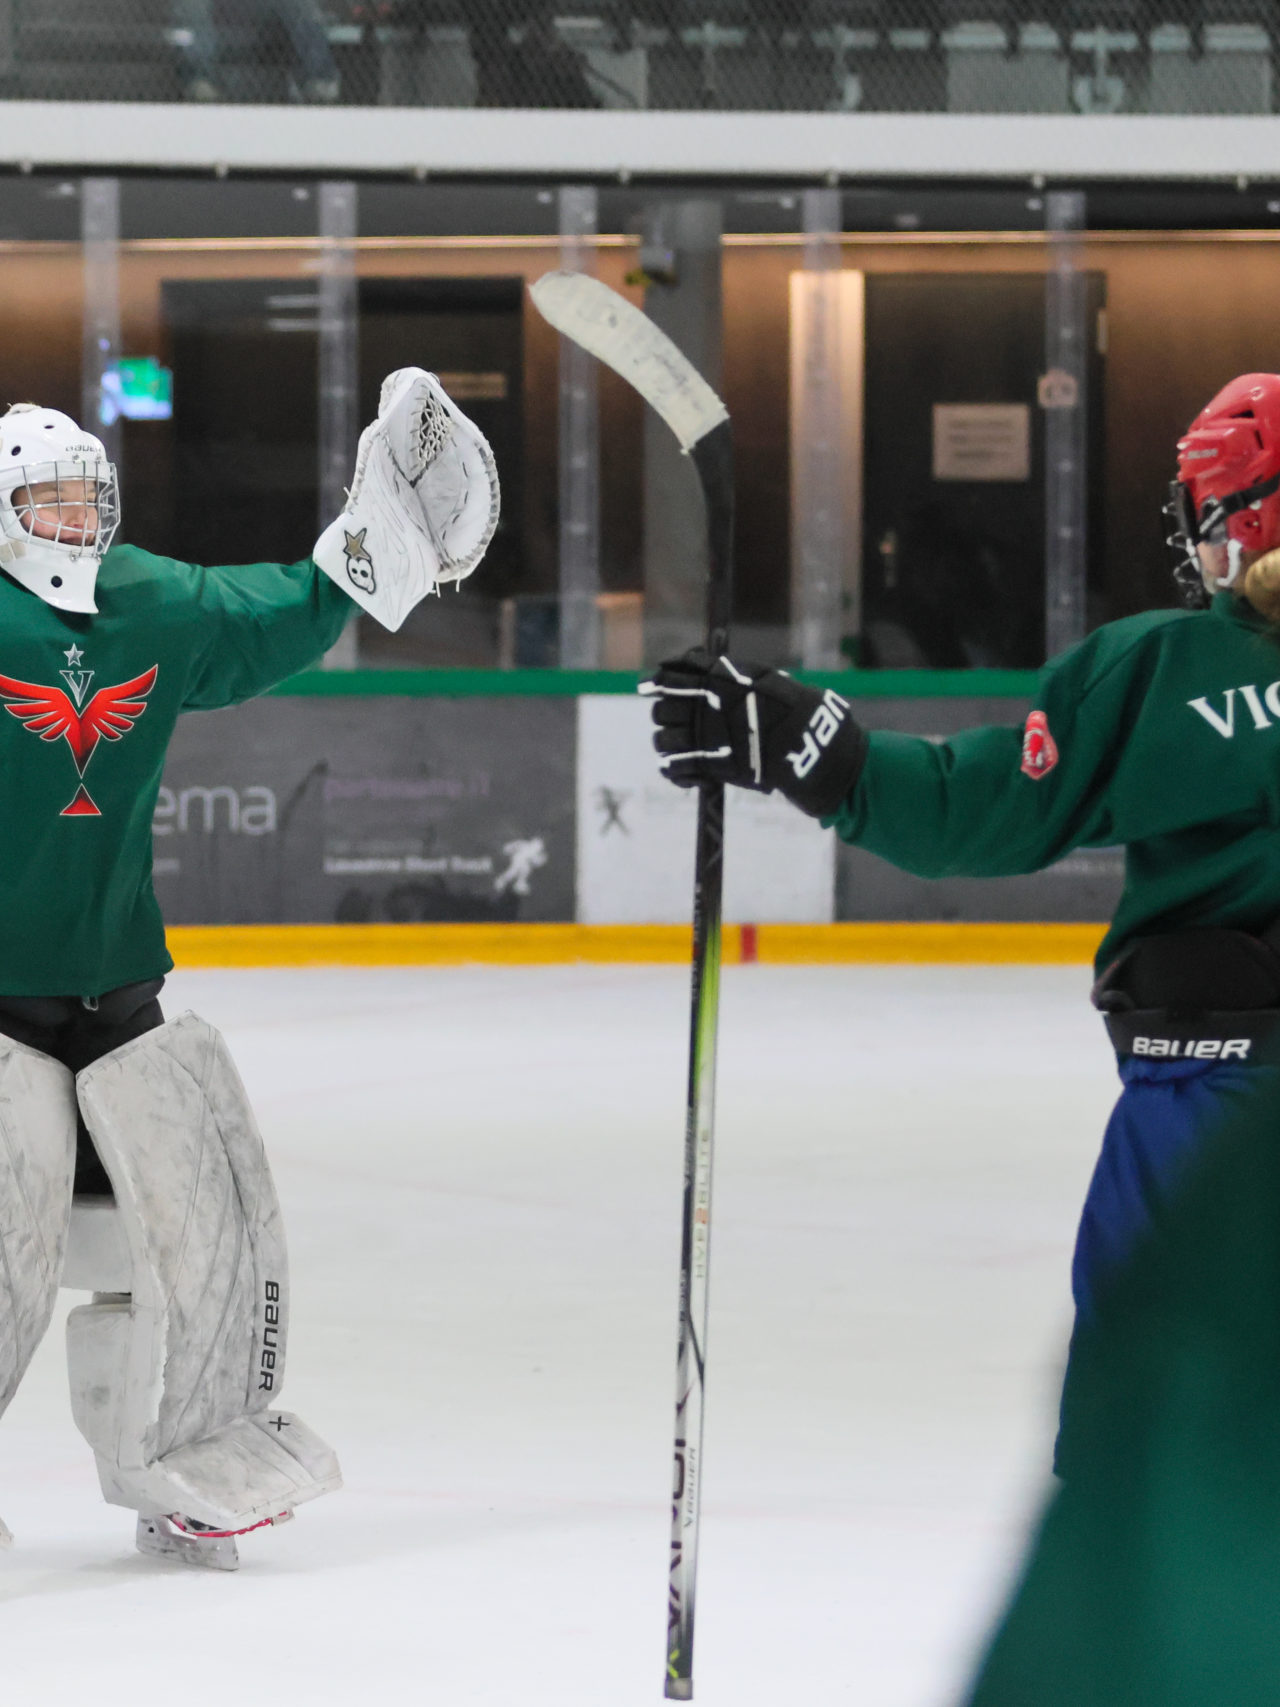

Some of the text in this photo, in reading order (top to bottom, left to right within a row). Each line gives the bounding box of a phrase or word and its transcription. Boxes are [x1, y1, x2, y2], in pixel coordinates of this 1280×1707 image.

[786, 688, 851, 779] UER
[1131, 1036, 1252, 1060] BAUER
[258, 1280, 280, 1392] BAUER
